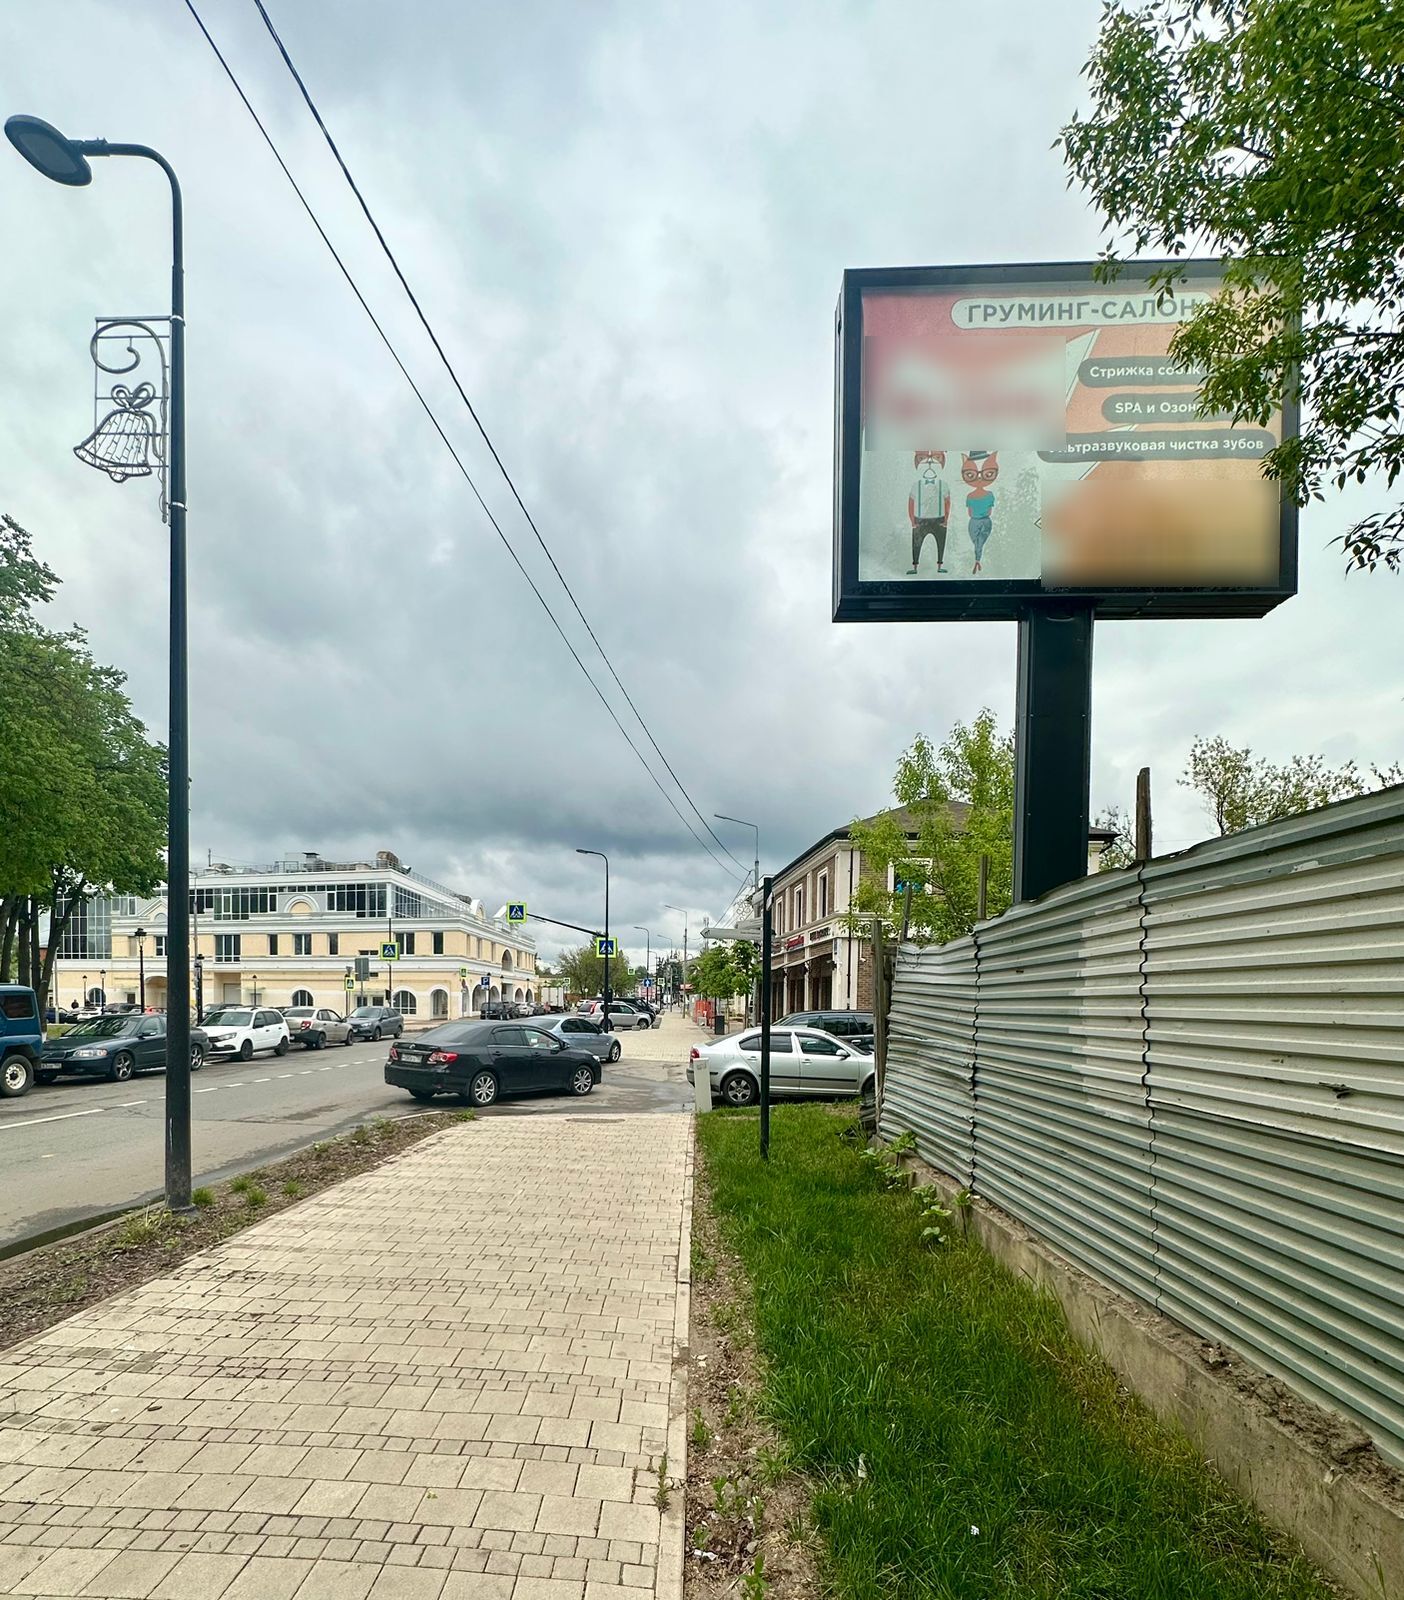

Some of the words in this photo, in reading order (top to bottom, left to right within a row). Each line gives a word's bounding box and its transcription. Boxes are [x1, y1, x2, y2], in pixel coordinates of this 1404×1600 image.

[967, 298, 1196, 324] ГРУМИНГ-САЛОН
[1089, 366, 1154, 379] Стрижка
[1115, 401, 1143, 414] SPA
[1146, 404, 1156, 414] и
[1049, 439, 1166, 455] ьтразвуковая
[1169, 438, 1219, 451] чистка
[1222, 437, 1264, 453] зубов
